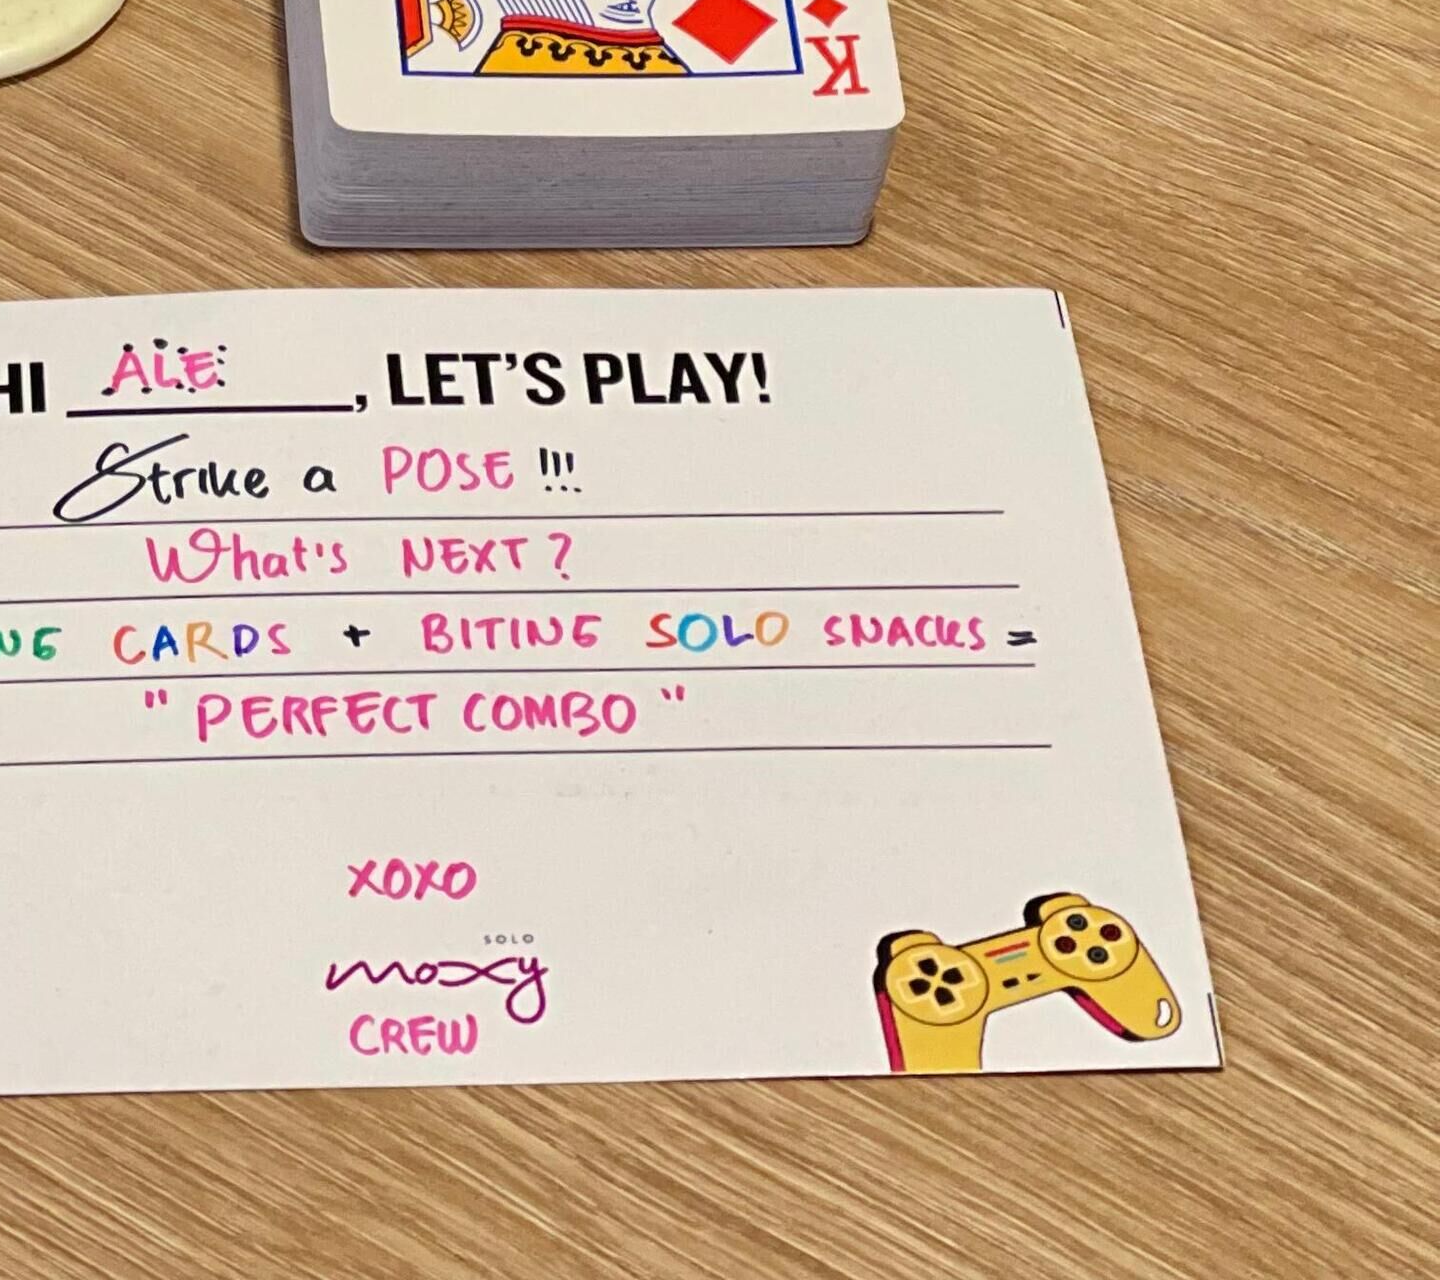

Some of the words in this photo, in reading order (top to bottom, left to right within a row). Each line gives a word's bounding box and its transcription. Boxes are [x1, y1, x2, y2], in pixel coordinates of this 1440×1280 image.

[805, 35, 870, 97] K
[101, 338, 227, 396] ALE
[386, 352, 566, 406] LET'S
[583, 352, 771, 404] PLAY!
[53, 433, 268, 523] Strike
[303, 466, 337, 493] a
[383, 446, 513, 494] POSE
[146, 528, 347, 583] What's
[402, 537, 528, 577] NEXT
[114, 622, 290, 664] CARDS
[646, 612, 788, 651] SOLO
[824, 614, 985, 650] SNACKS
[198, 692, 437, 742] PERFECT
[464, 692, 636, 736] COMBO
[348, 859, 476, 900] XOXO
[484, 934, 534, 945] SOLO
[326, 957, 548, 1024] moxy
[350, 1014, 477, 1055] CREW
